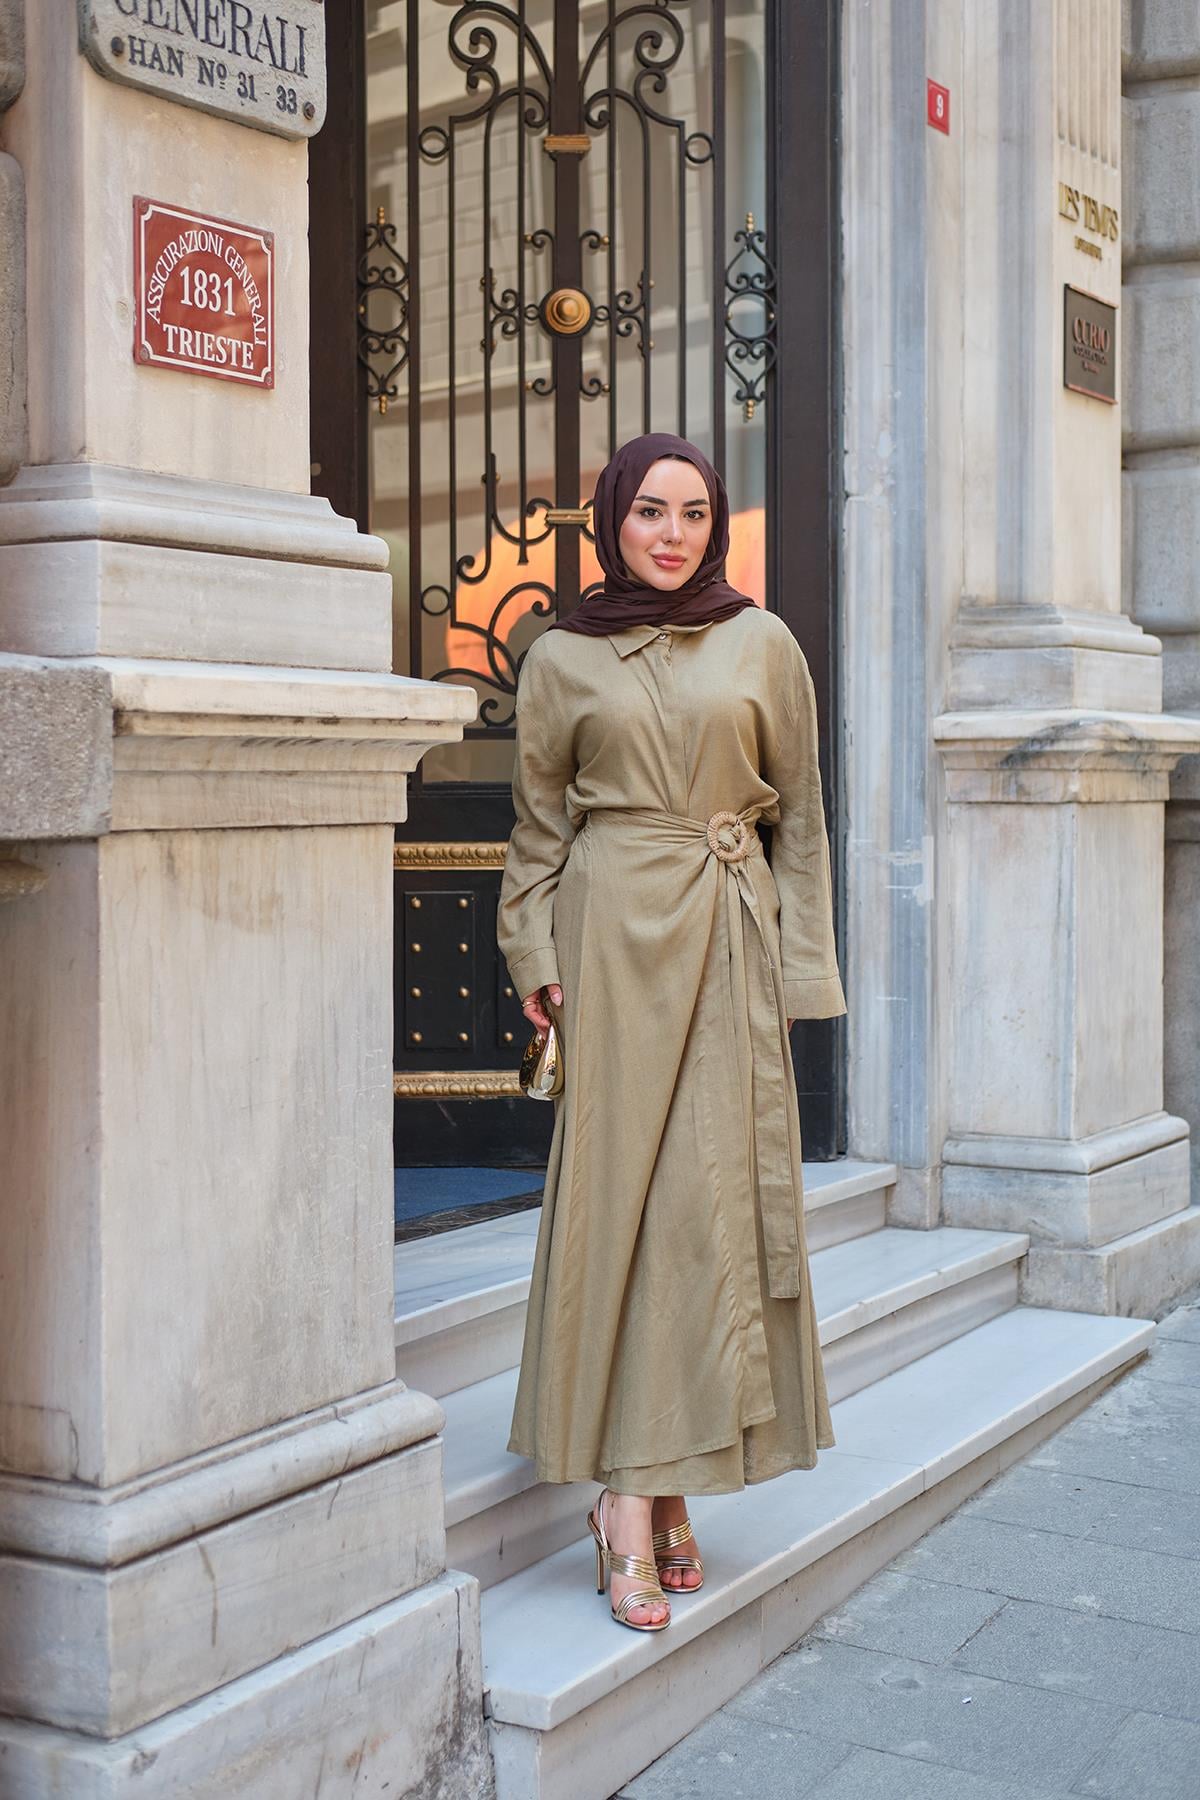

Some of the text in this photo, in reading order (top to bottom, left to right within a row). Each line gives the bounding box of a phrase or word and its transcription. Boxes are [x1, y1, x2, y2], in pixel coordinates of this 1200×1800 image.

[114, 0, 308, 79] ENERALI
[127, 34, 184, 78] HAN
[236, 71, 258, 103] 31
[275, 84, 298, 115] 33
[147, 230, 267, 346] ASSICURAZIONI GENERALI
[180, 265, 236, 317] 1831
[162, 323, 254, 370] TRIESTE
[1072, 316, 1111, 354] CURIO
